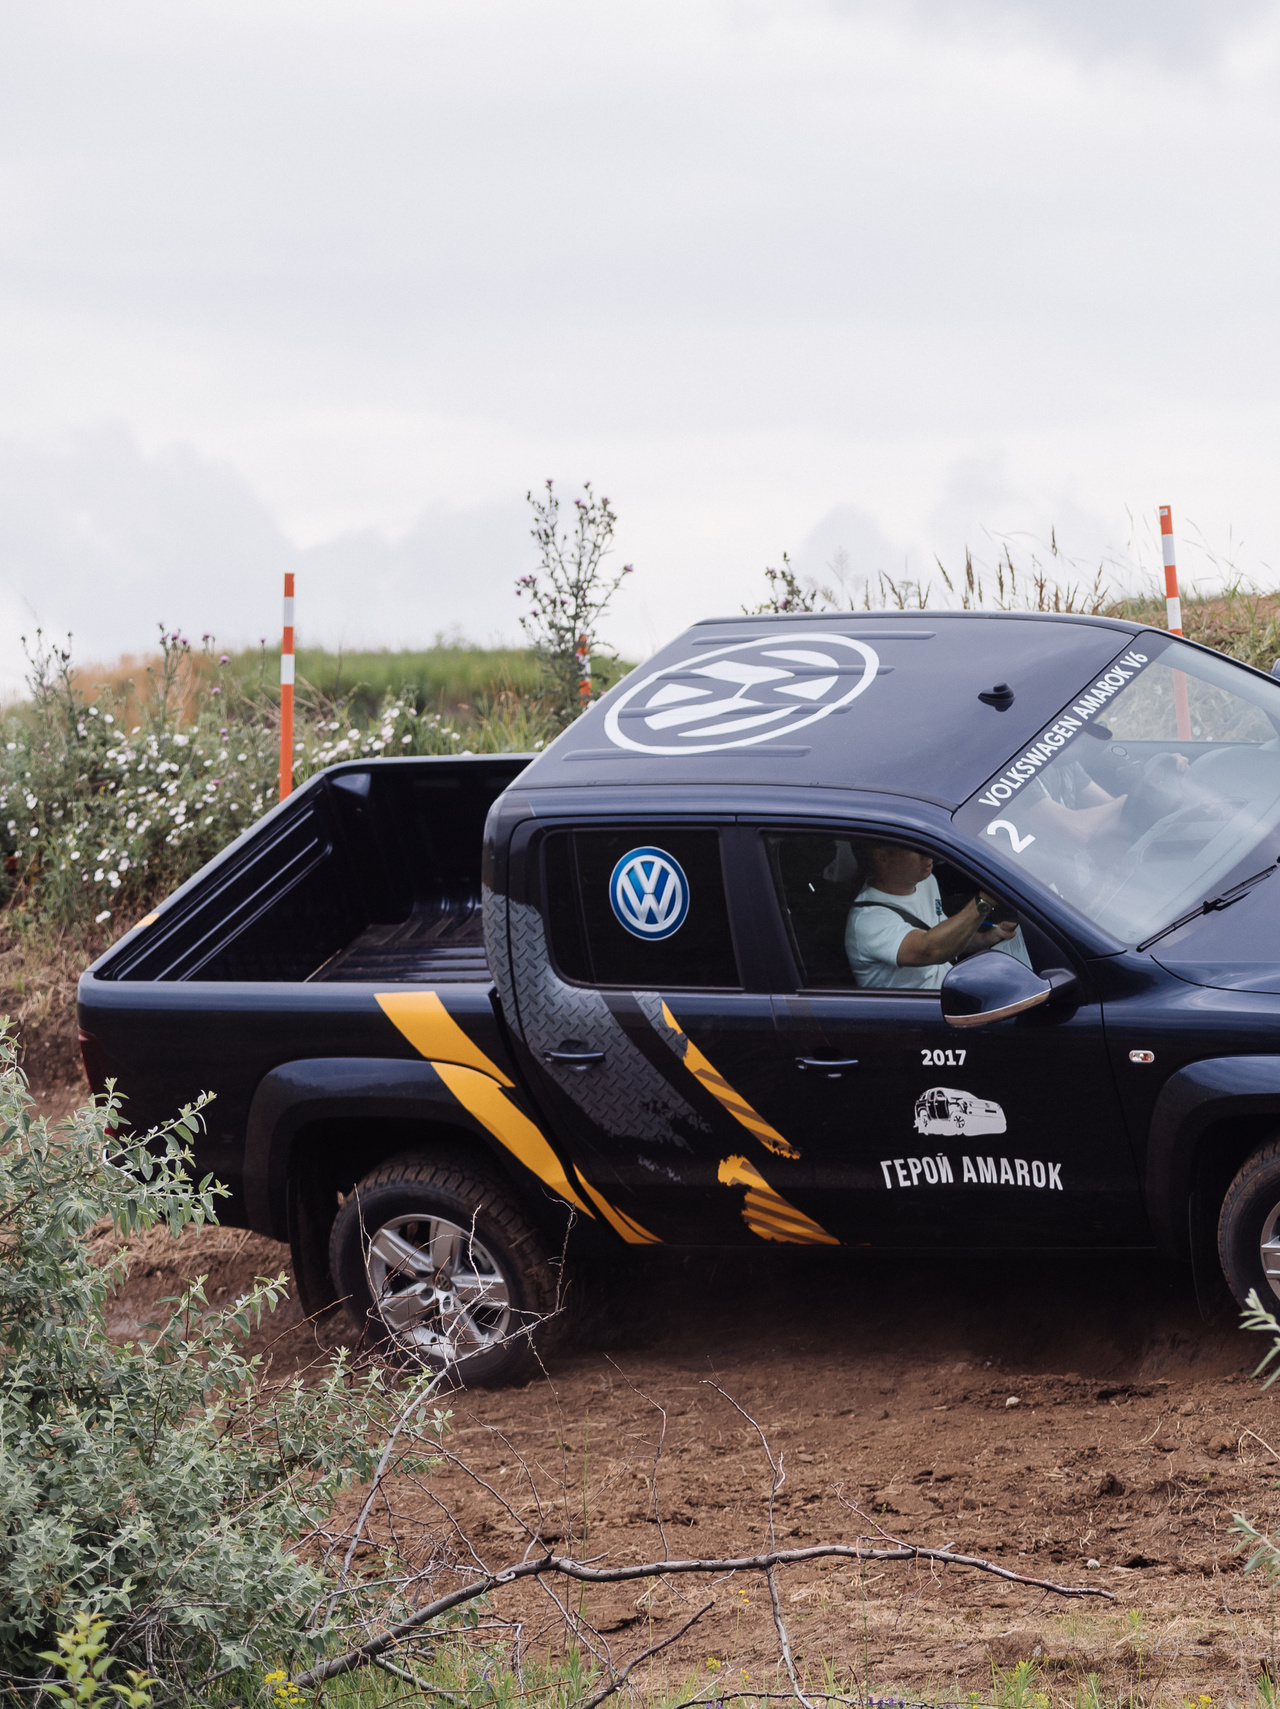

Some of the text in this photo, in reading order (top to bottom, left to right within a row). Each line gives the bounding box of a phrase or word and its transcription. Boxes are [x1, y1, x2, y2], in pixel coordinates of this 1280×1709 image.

[978, 651, 1148, 807] VOLKSWAGEN AMAROK V6
[987, 819, 1036, 854] 2
[921, 1049, 966, 1066] 2017
[880, 1153, 1063, 1190] ГЕРОЙ AMAROK
